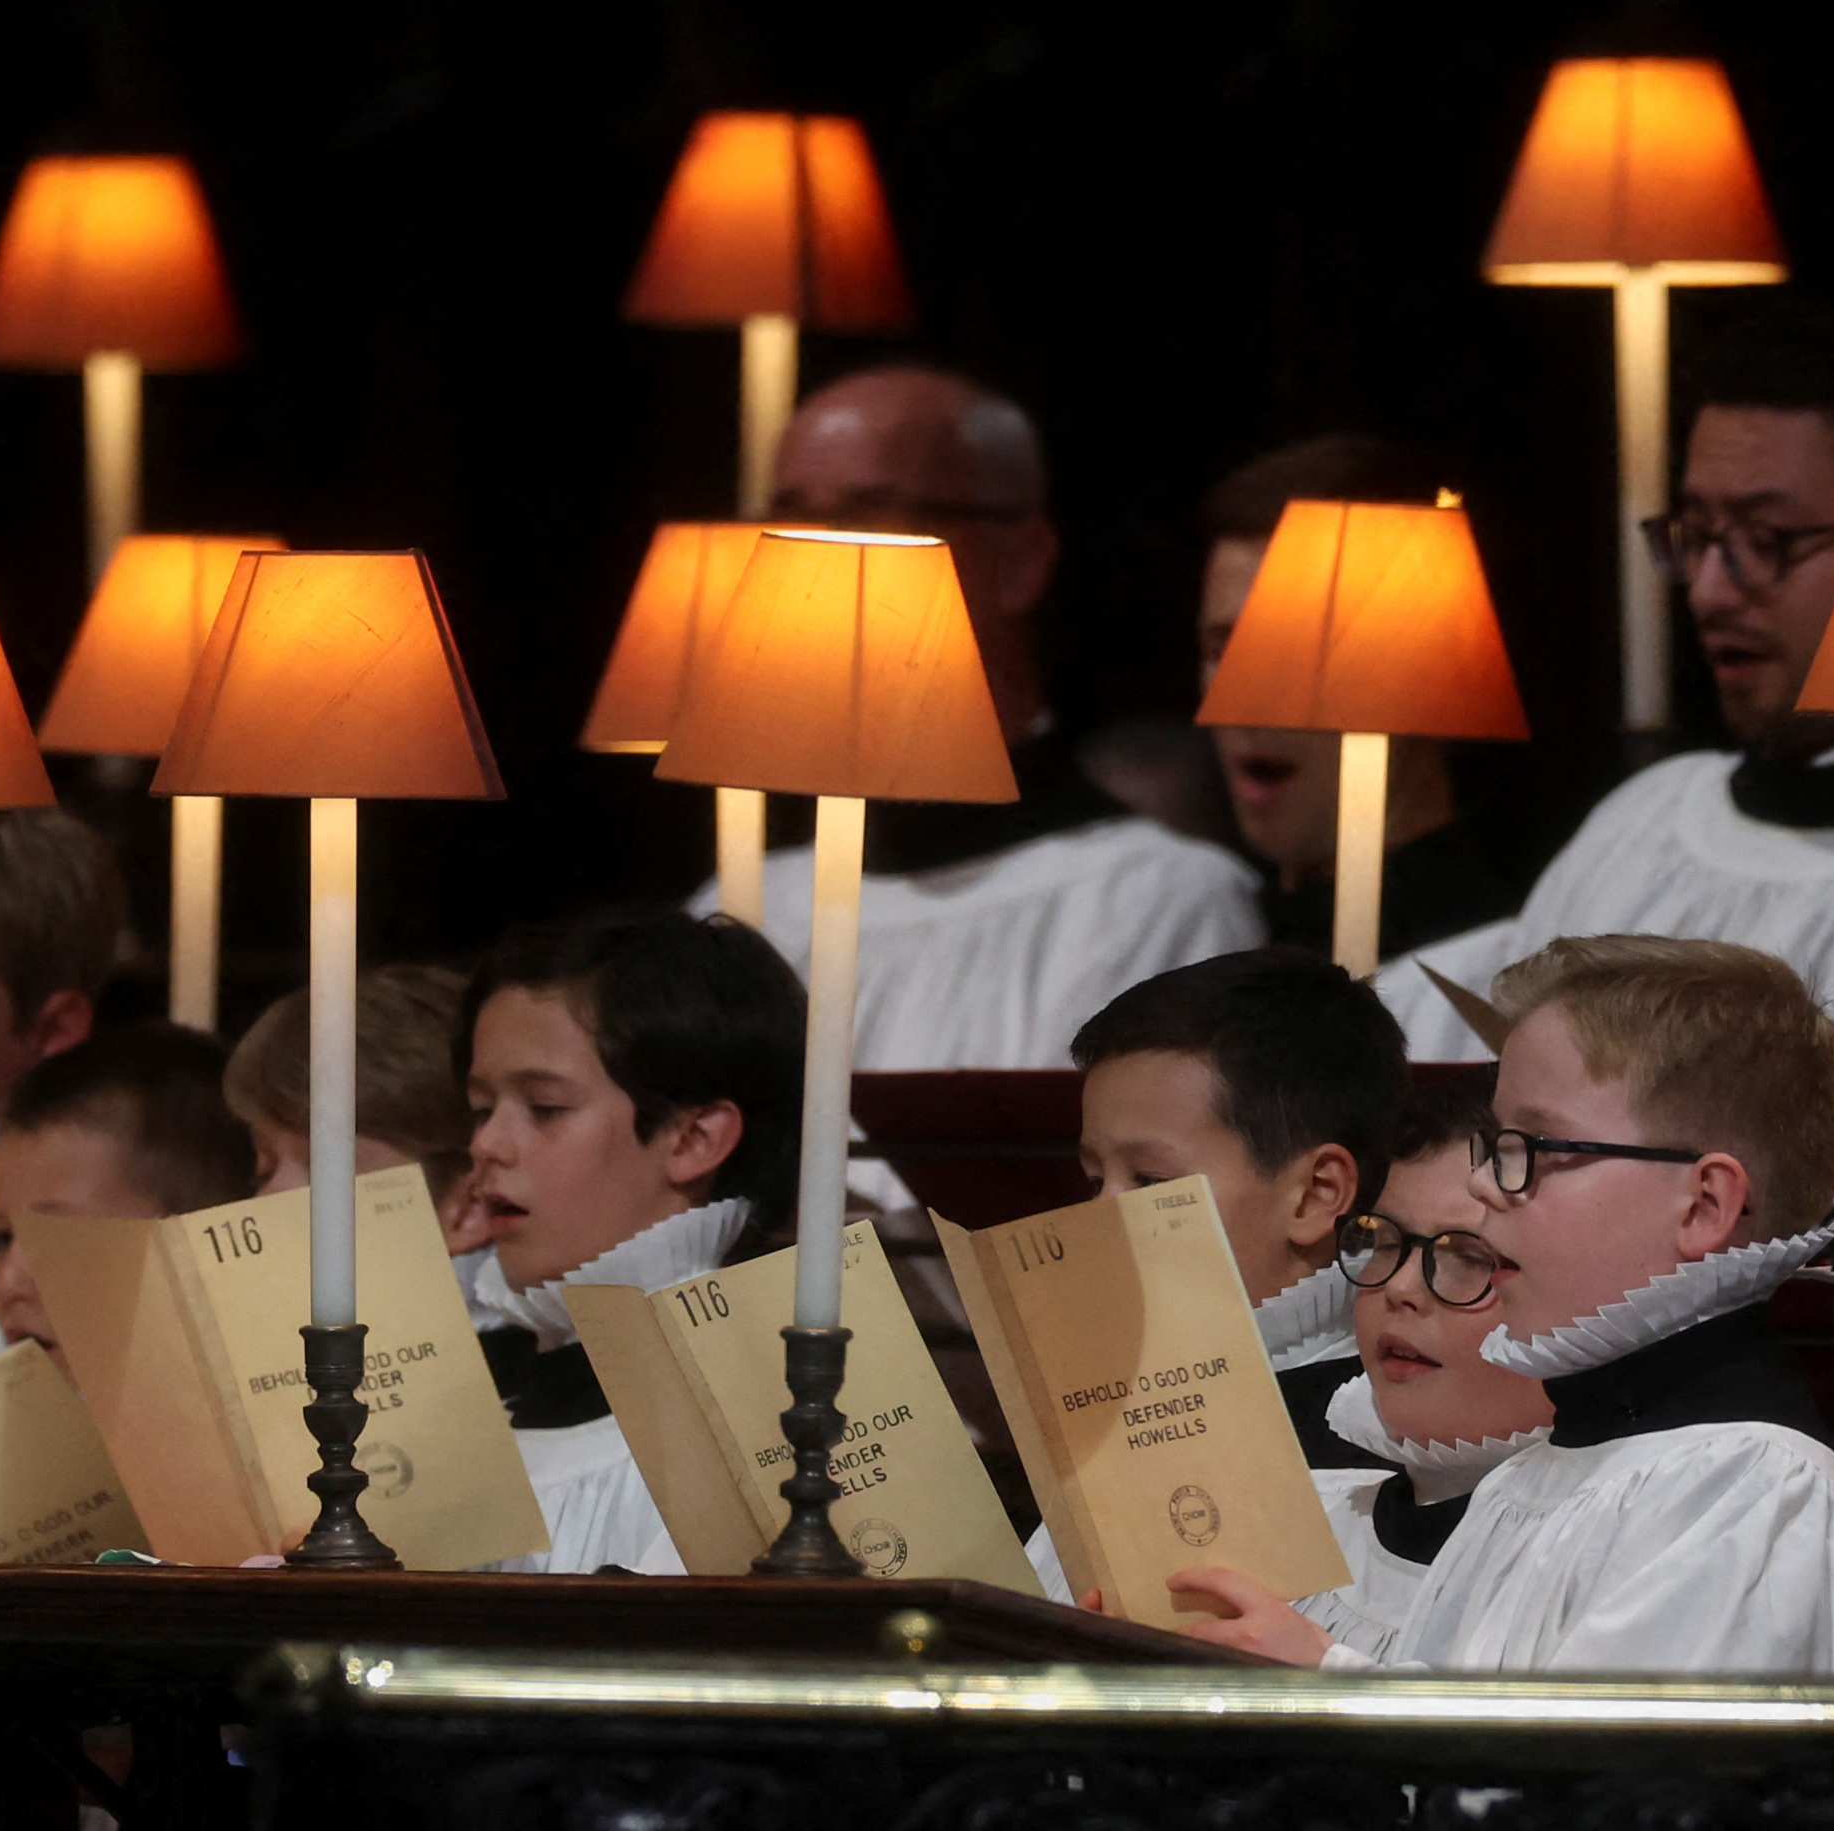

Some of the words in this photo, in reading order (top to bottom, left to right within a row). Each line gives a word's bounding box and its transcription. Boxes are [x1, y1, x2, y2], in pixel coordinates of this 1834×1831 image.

[203, 1216, 263, 1263] 116
[1008, 1222, 1065, 1272] 116
[675, 1280, 730, 1327] 116
[249, 1368, 309, 1395] BEHOL
[364, 1352, 392, 1371] OD
[396, 1342, 438, 1365] OUR
[1138, 1376, 1151, 1392] O
[1154, 1367, 1190, 1388] GOD
[1193, 1357, 1230, 1380] OUR
[841, 1421, 868, 1443] OD
[872, 1405, 914, 1431] OUR
[1123, 1393, 1207, 1427] DEFENDER
[1127, 1418, 1207, 1450] HOWELLS
[827, 1443, 886, 1476] ENDER
[841, 1467, 888, 1497] ELLS
